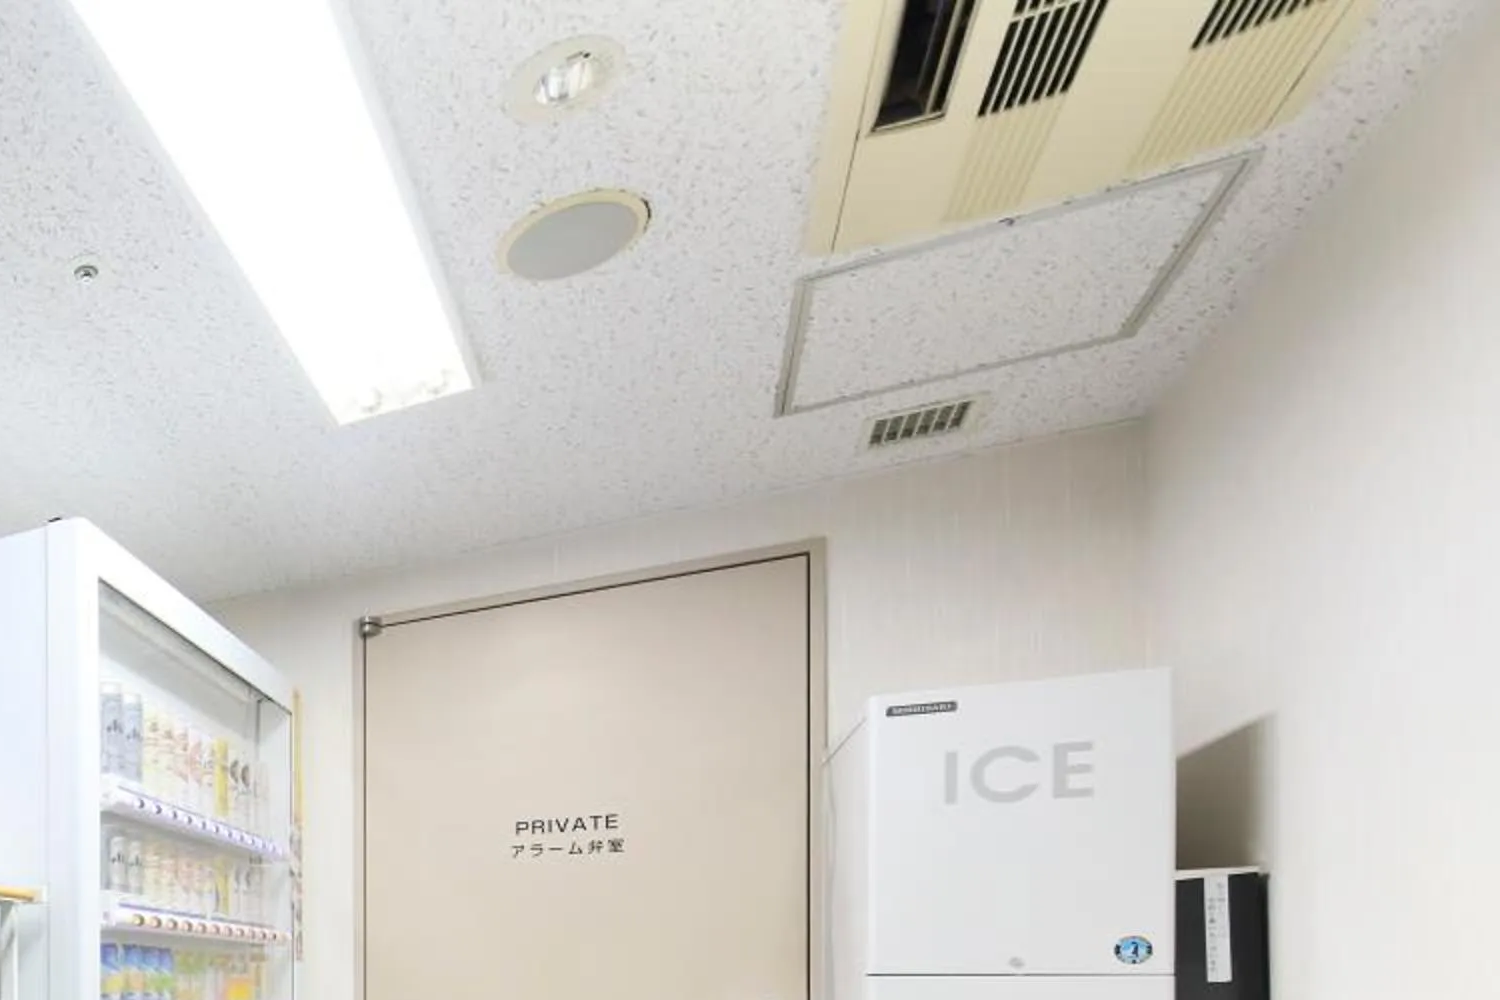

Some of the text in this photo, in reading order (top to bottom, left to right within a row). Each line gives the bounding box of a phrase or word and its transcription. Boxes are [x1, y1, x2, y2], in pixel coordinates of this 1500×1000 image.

[943, 740, 1095, 806] ICE
[515, 813, 619, 836] PRIVATE
[511, 838, 626, 859] アラーム弁室
